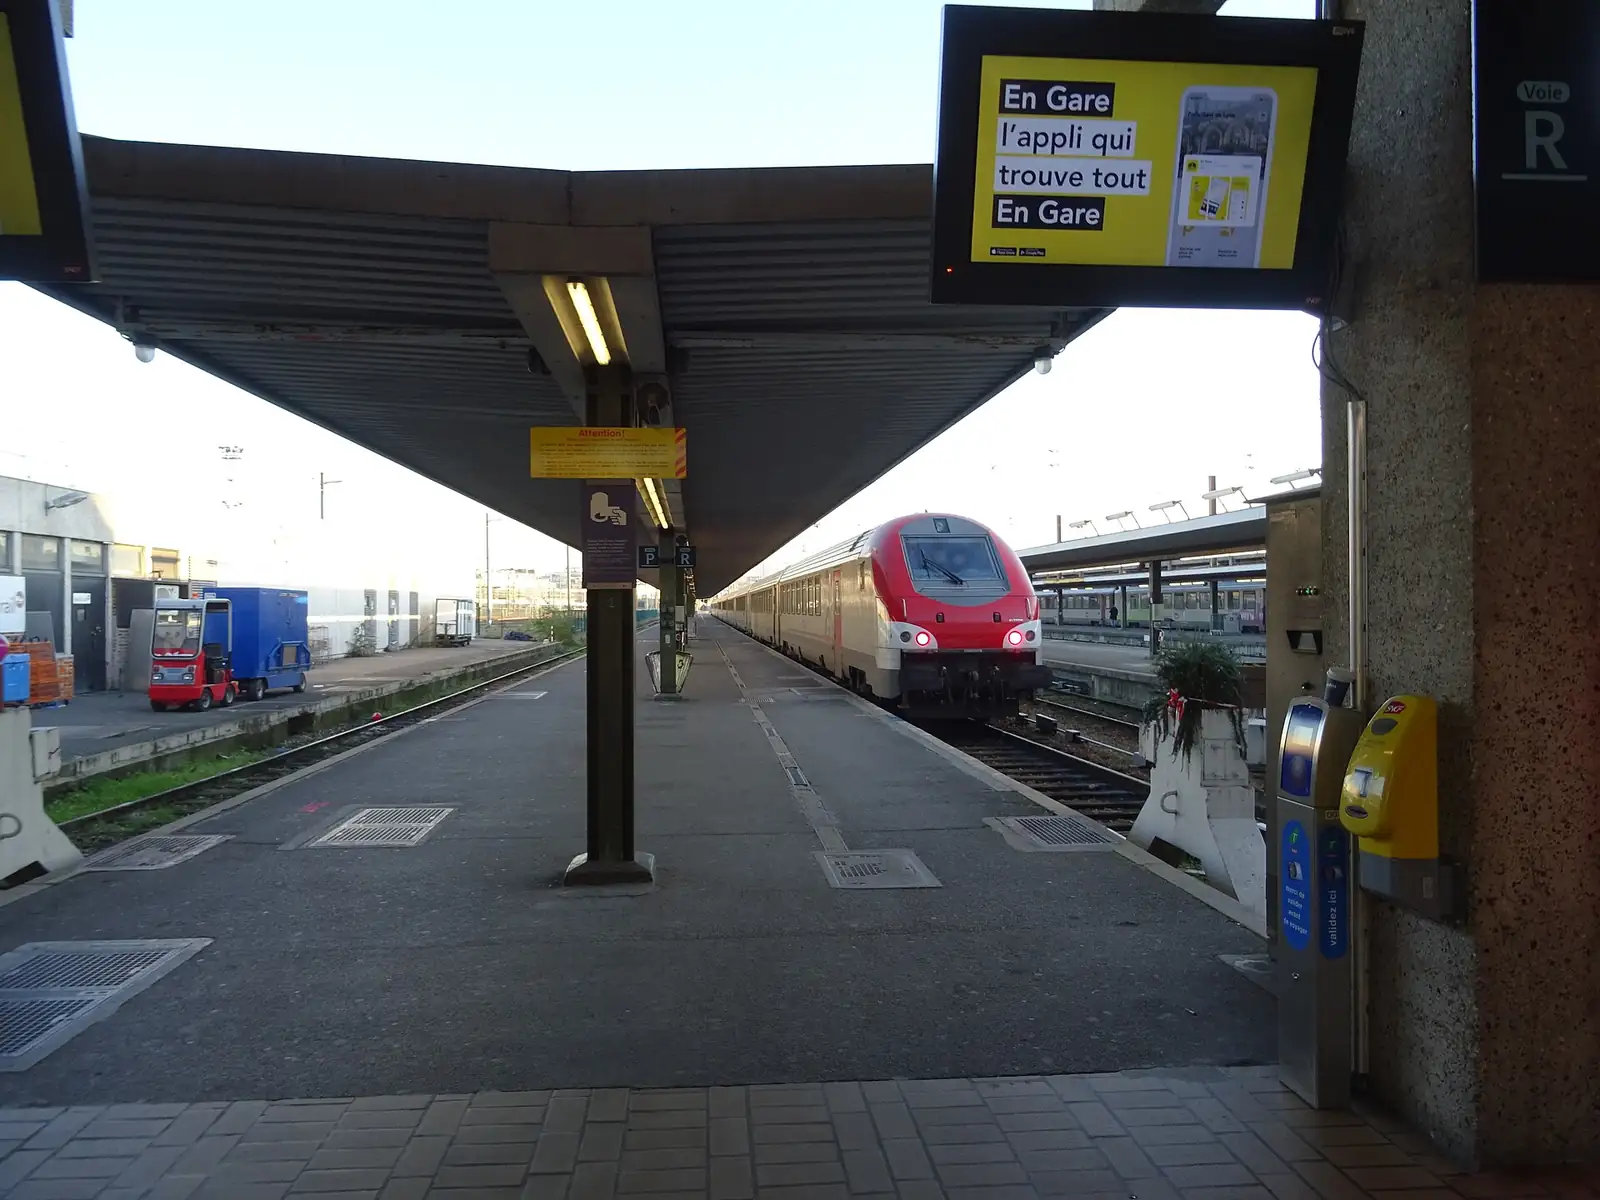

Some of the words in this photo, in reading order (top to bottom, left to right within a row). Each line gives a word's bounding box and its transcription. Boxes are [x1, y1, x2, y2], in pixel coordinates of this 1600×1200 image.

[1004, 84, 1037, 109] En
[1046, 85, 1110, 112] Gare
[1523, 83, 1563, 100] Voie
[1002, 122, 1083, 155] l'appli
[1092, 127, 1133, 156] qui
[1525, 110, 1568, 169] R
[999, 165, 1083, 187] trouve
[1092, 168, 1147, 189] tout
[997, 199, 1029, 223] En
[1038, 200, 1100, 225] Gare
[646, 553, 655, 564] P
[681, 553, 690, 564] R
[1328, 907, 1337, 947] validez
